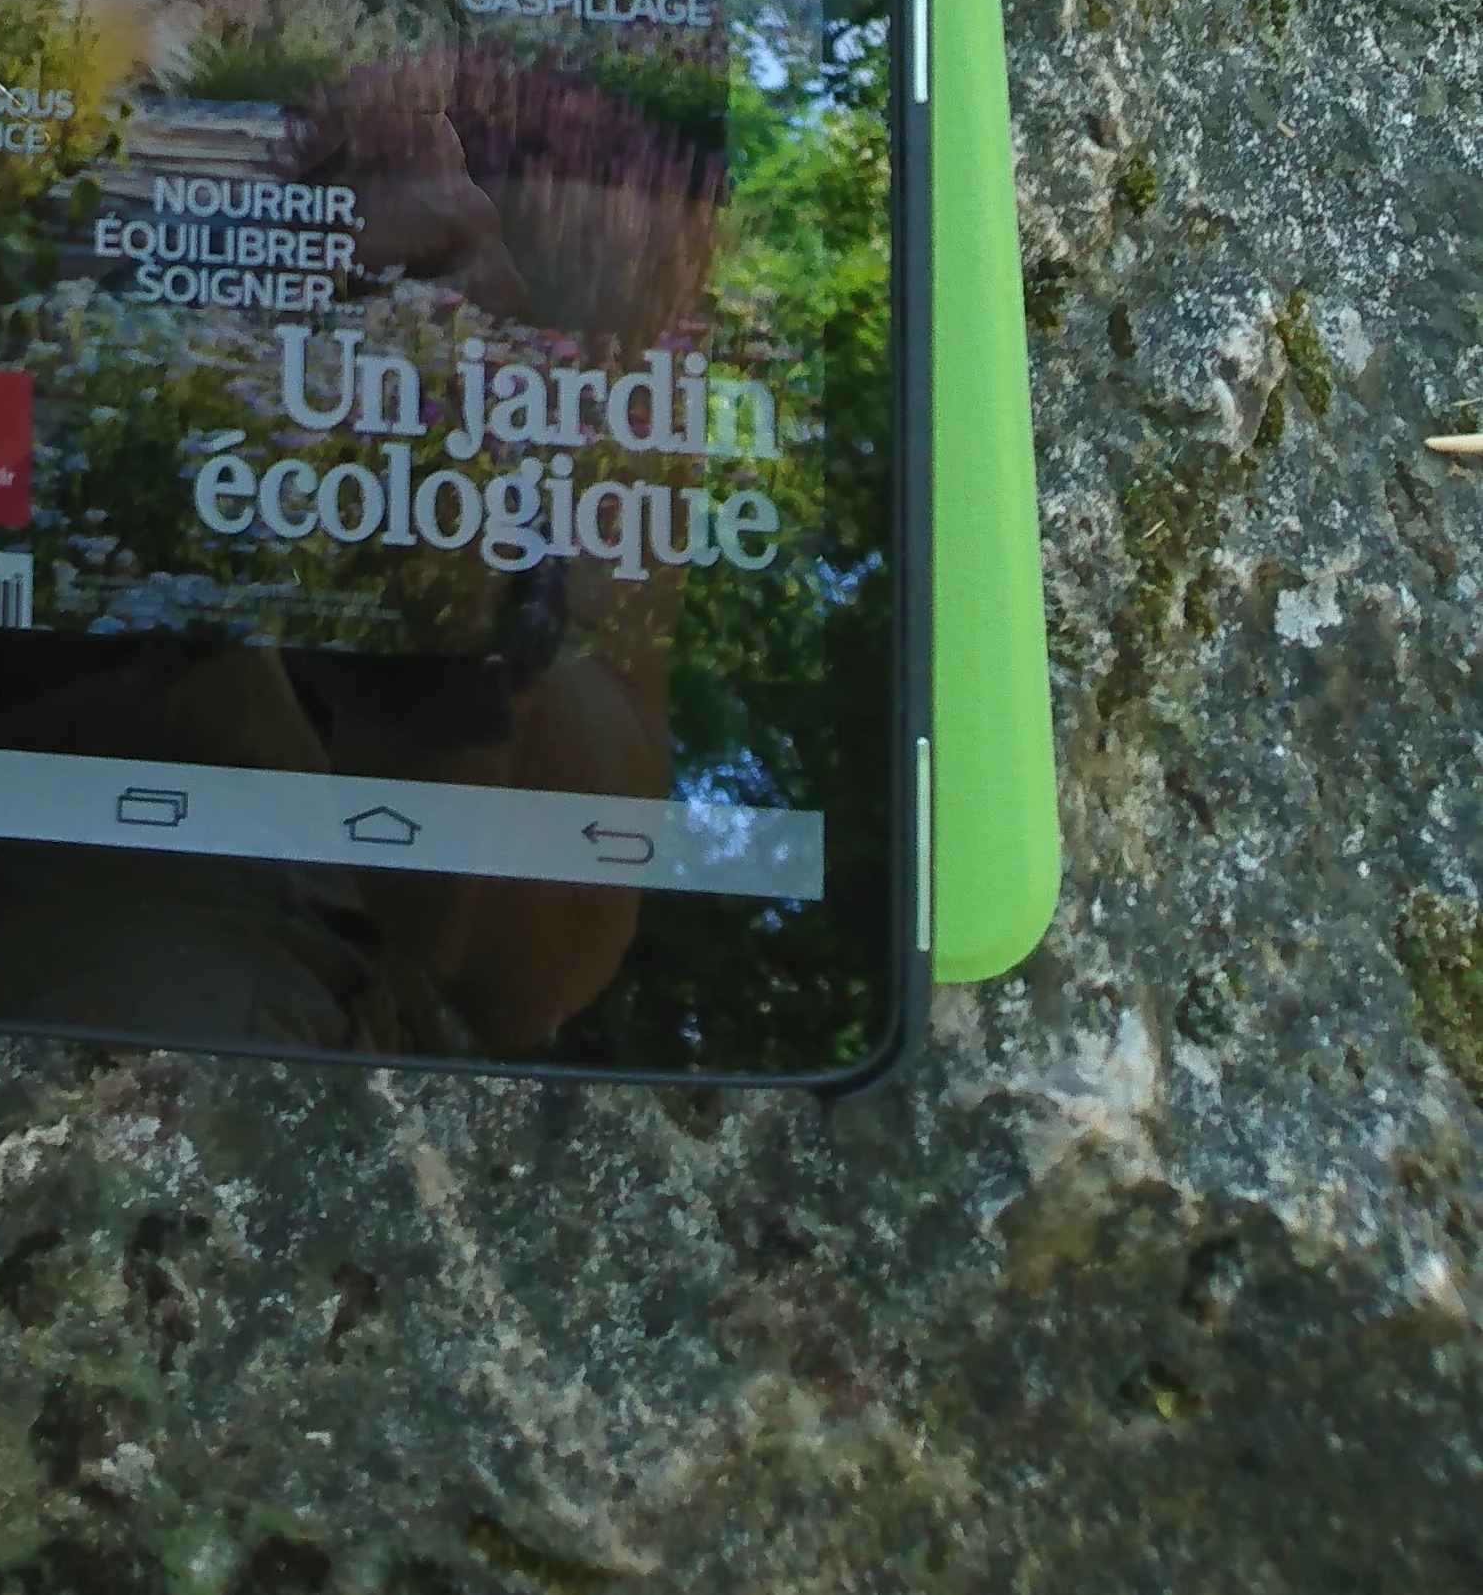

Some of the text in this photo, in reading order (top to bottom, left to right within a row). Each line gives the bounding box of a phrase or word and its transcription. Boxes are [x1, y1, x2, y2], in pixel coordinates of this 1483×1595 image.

[94, 211, 365, 277] ÉQUILIBRER,
[153, 175, 366, 232] NOURRIR,
[275, 323, 783, 460] Un jardin
[194, 428, 780, 582] écologique
